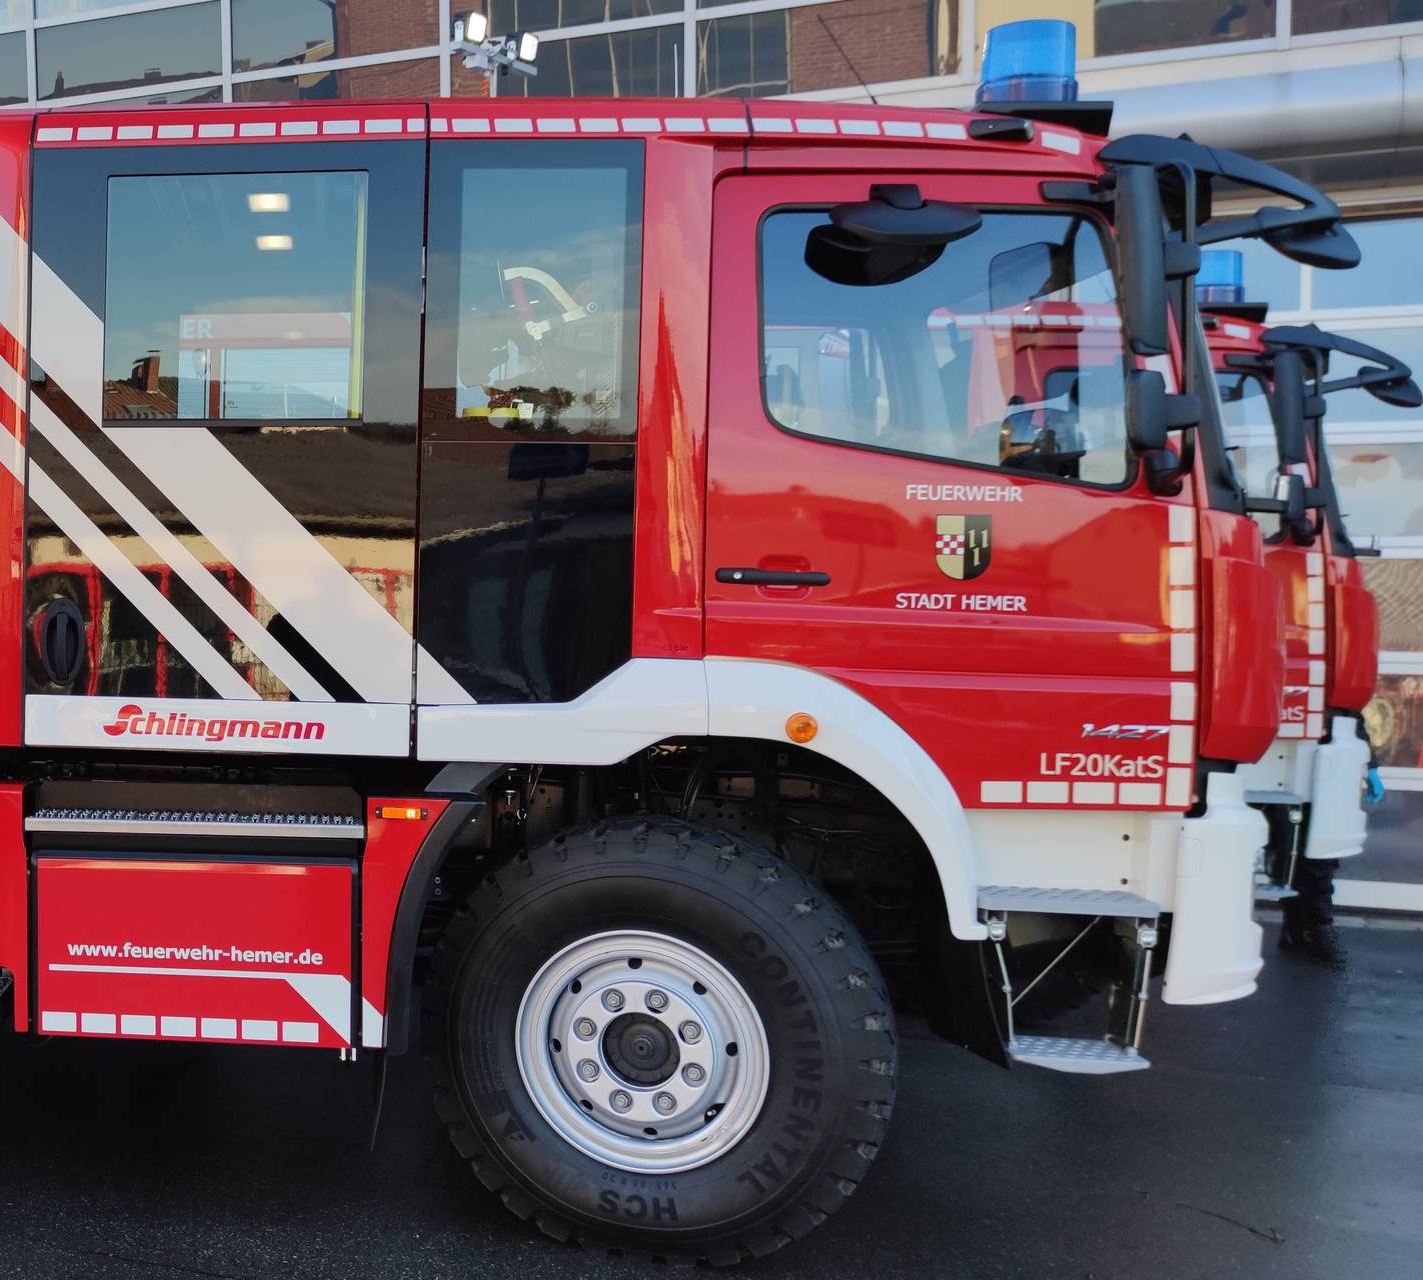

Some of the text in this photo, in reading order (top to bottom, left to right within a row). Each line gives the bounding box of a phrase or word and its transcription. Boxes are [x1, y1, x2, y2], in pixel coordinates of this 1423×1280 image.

[906, 485, 1023, 502] FEUERWEHR
[895, 592, 1027, 612] STADT HEMER
[103, 704, 325, 742] Schlingmann
[1081, 723, 1170, 740] 1427
[1040, 752, 1164, 778] LF20KatS
[67, 942, 324, 966] www.feuerwehr-hemer.de
[735, 930, 826, 1195] CONTINENTAL
[598, 1189, 678, 1223] HCS
